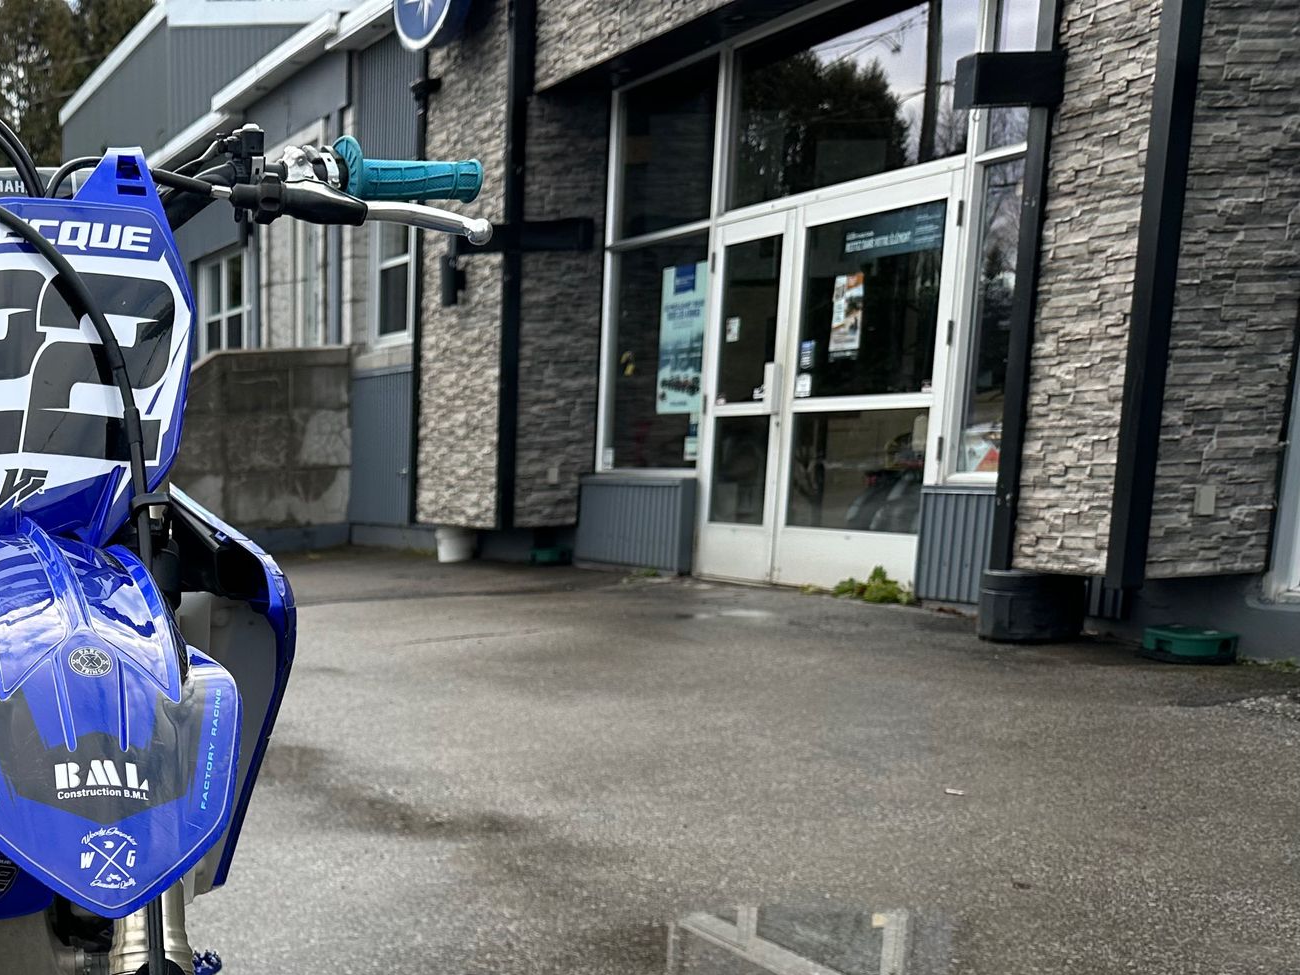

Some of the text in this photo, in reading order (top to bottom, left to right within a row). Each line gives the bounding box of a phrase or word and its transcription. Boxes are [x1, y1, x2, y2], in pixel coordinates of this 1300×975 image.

[200, 688, 222, 810] FACTORY RACING
[57, 787, 122, 800] Construction
[80, 849, 137, 869] W G
